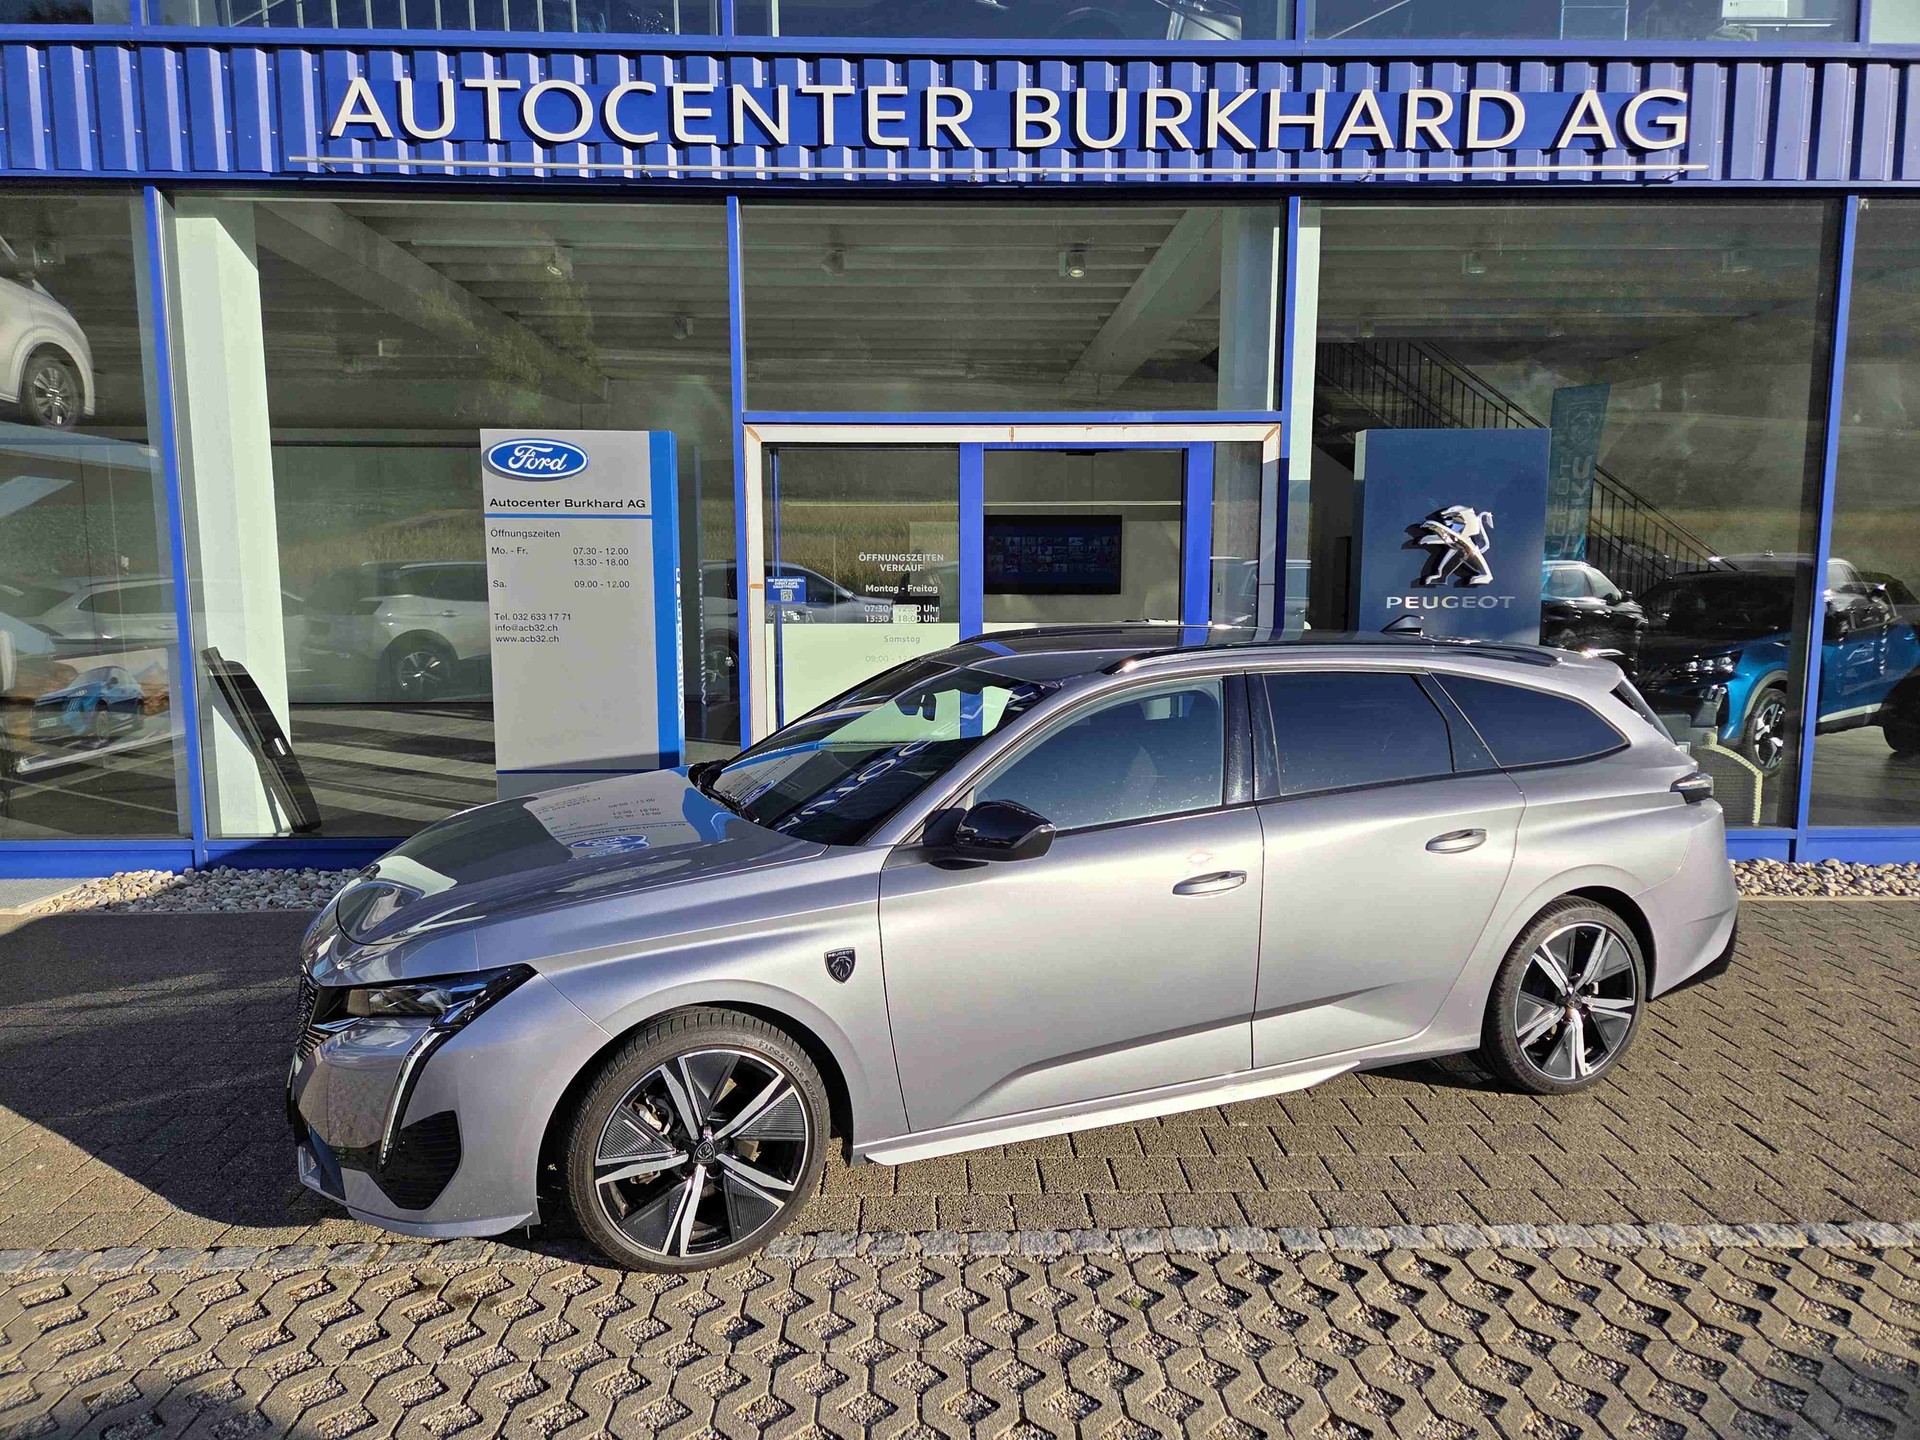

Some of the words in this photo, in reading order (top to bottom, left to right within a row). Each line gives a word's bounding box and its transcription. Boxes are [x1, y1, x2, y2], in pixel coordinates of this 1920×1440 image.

[330, 76, 974, 148] AUTOCENTER
[1015, 87, 1527, 150] BURKHARD
[1556, 88, 1687, 151] AG
[507, 445, 569, 472] Ford
[489, 498, 561, 508] Autocenter
[564, 498, 623, 509] Burkhard
[627, 499, 646, 509] AG
[491, 546, 508, 555] Mo.
[516, 546, 529, 555] Fr.
[573, 547, 597, 556] 07.30
[605, 547, 629, 556] 12.00
[858, 551, 944, 562] ÖFFNUNGSZEITEN
[573, 558, 597, 567] 13.30
[606, 558, 629, 567] 18.00
[880, 563, 923, 572] VERKAUF
[492, 579, 507, 588] Sa.
[574, 580, 598, 589] 09.00
[606, 580, 630, 589] 12.00
[865, 584, 899, 594] Montag
[907, 584, 938, 594] Freitag
[1385, 595, 1516, 610] PEUGEOT
[864, 604, 889, 613] 07:30
[923, 604, 940, 612] Uhr
[494, 612, 510, 621] Tel.
[512, 612, 529, 621] 032
[530, 612, 547, 621] 633
[549, 612, 559, 621] 17
[561, 612, 571, 621] 71
[865, 614, 889, 623] 13:30
[898, 614, 922, 623] 18:00
[923, 614, 940, 623] Uhr
[495, 623, 558, 632] info@acb32.ch
[495, 635, 560, 643] www.acb32.ch
[883, 635, 921, 644] Samstag
[865, 655, 889, 663] 09:00
[827, 950, 854, 958] PEUGEOT
[758, 1040, 805, 1078] Firestone
